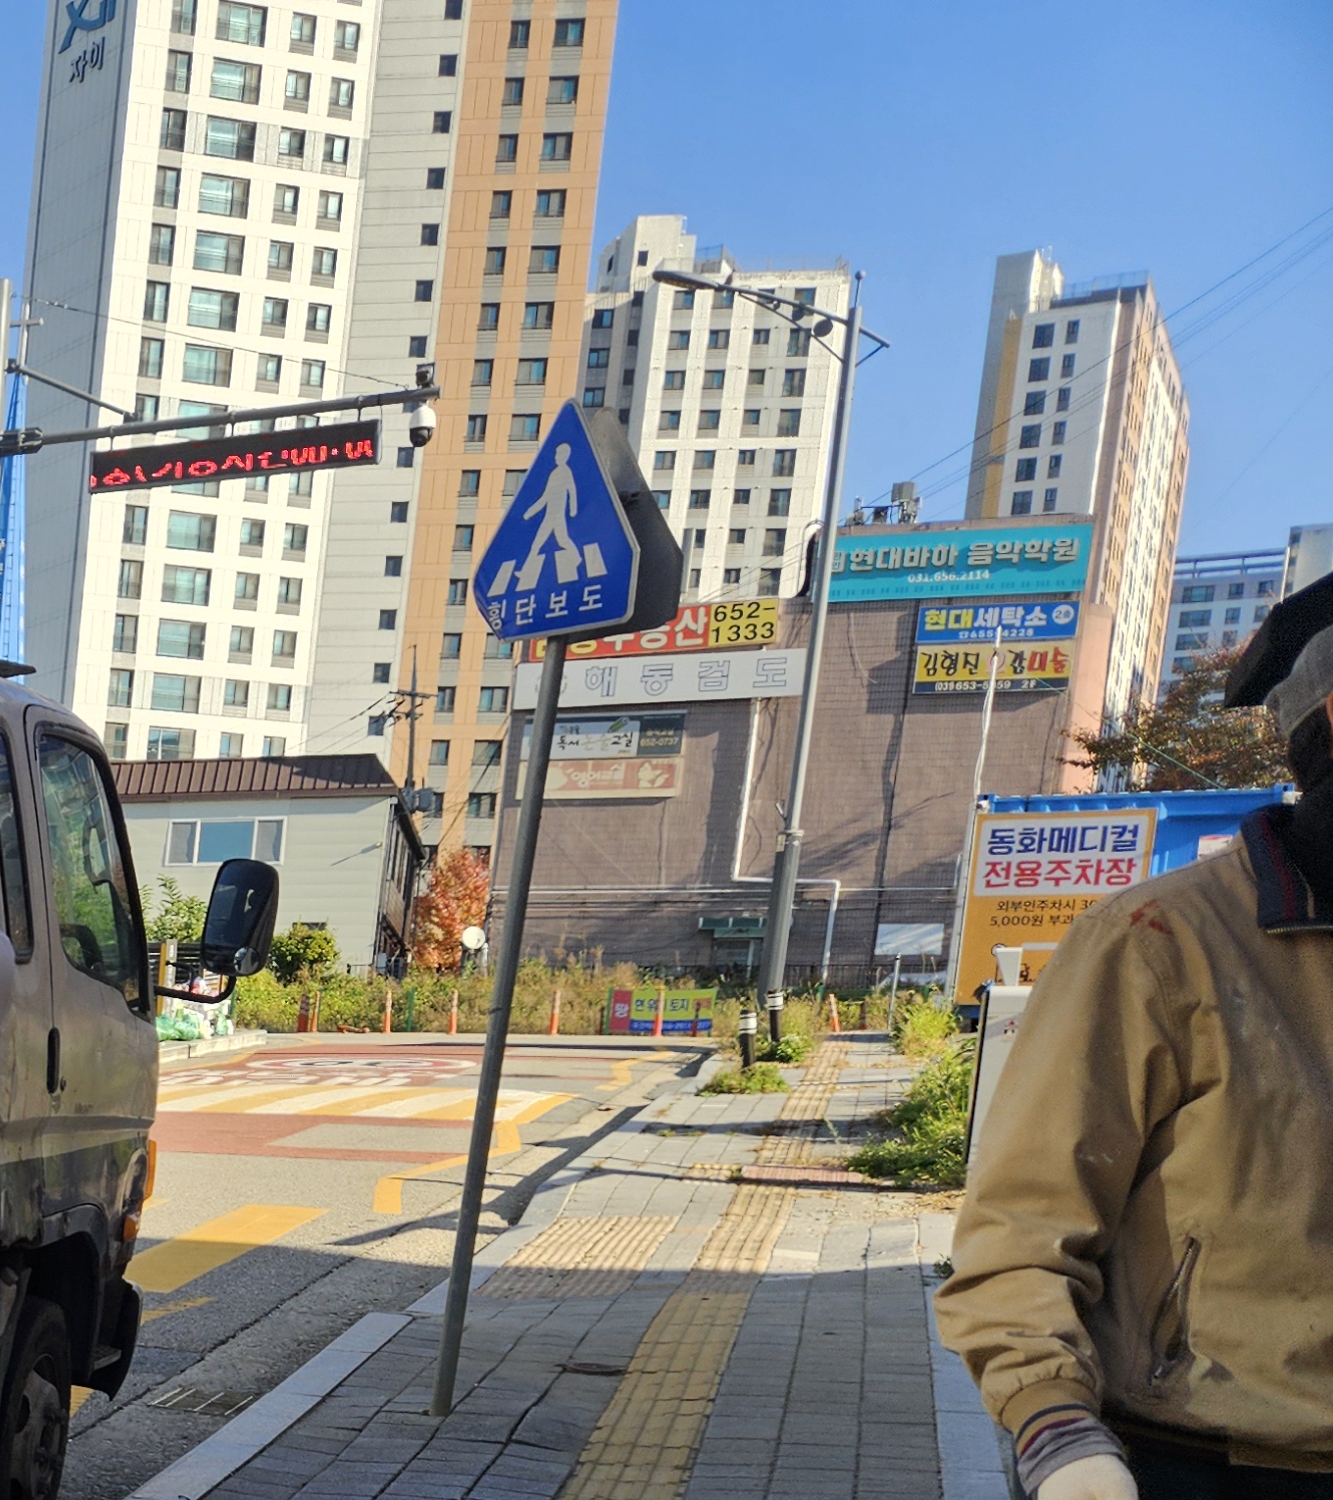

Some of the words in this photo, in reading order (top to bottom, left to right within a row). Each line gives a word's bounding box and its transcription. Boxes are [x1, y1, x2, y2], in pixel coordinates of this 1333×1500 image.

[69, 36, 106, 83] 자이
[849, 542, 958, 572] 현대바하
[967, 537, 1079, 566] 음악학원
[907, 569, 990, 583] 031.656.2114
[486, 584, 604, 631] 횡단보도
[713, 601, 776, 624] 652-
[924, 605, 1047, 631] 현대세탁소
[711, 622, 774, 644] 1333
[584, 656, 788, 697] 해동검도
[987, 824, 1140, 856] 동화메디컬
[983, 857, 1137, 888] 전용주차장
[997, 899, 1076, 912] 외부인주차시
[990, 915, 1043, 927] 5,000원
